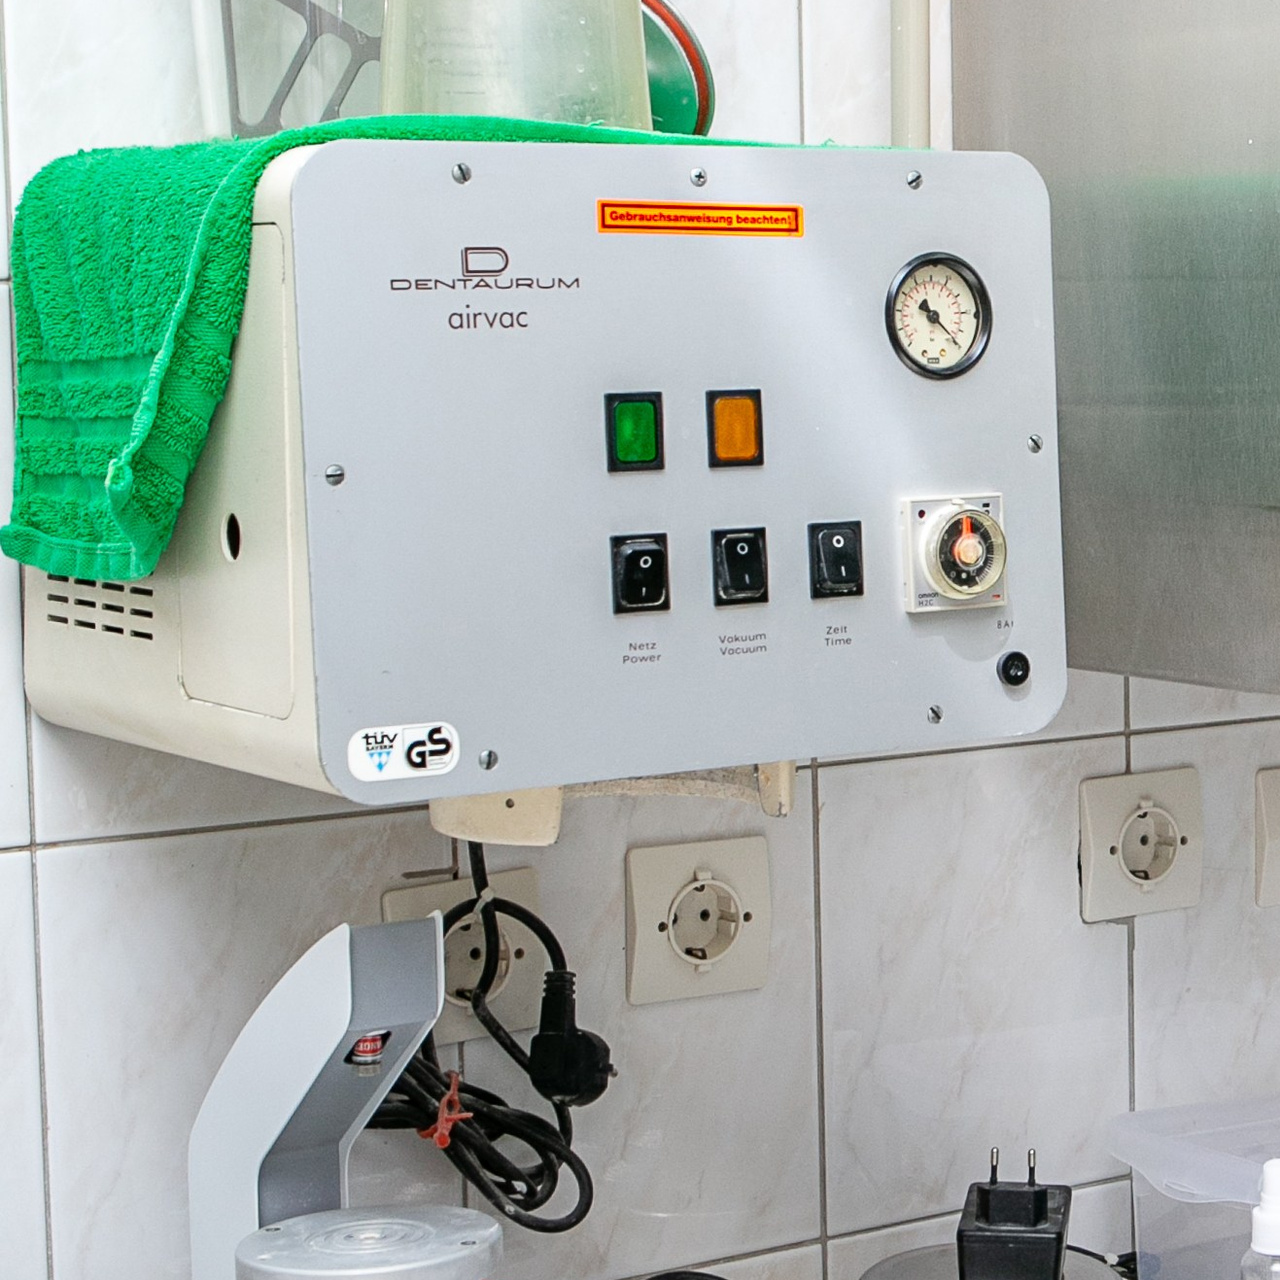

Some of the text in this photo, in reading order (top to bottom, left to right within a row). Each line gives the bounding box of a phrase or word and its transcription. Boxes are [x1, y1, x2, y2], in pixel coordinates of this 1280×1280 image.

[609, 210, 733, 226] Gebrauchsanweisung
[390, 277, 580, 291] DENTAURUM
[448, 304, 528, 329] airvac
[826, 626, 848, 635] Zeit
[719, 632, 767, 644] Vakuum
[825, 636, 852, 646] Time
[628, 642, 657, 651] Netz
[720, 644, 767, 656] Vacuum
[622, 653, 662, 664] Power
[406, 726, 452, 768] GS
